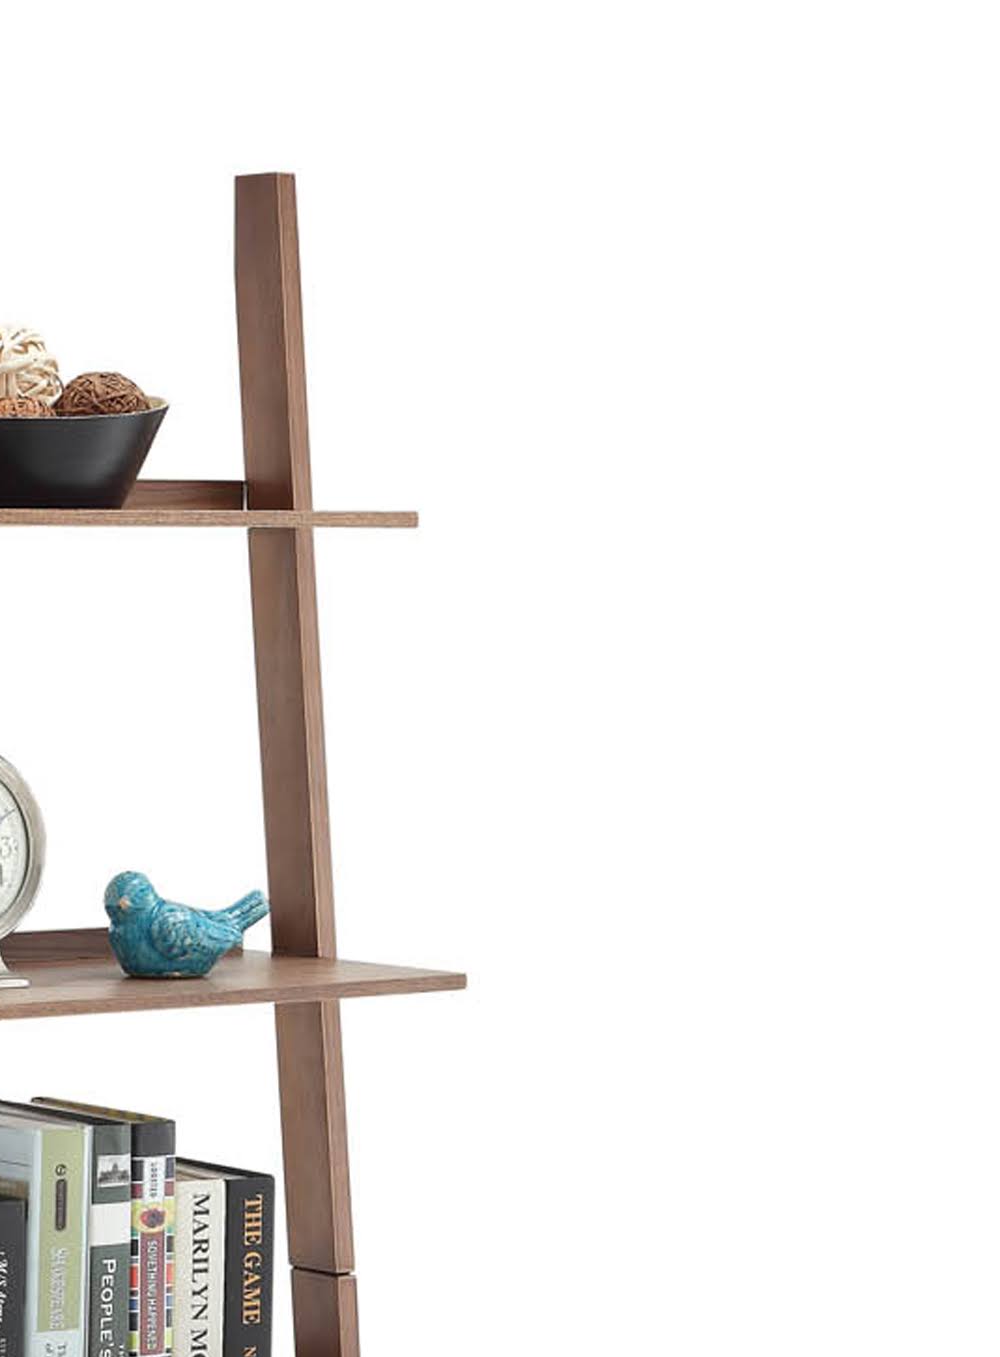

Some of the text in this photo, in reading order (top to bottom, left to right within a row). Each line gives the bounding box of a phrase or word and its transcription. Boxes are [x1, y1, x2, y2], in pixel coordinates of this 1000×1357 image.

[0, 836, 12, 858] 3
[192, 1194, 211, 1321] MARILYN
[242, 1194, 263, 1325] THE GAME
